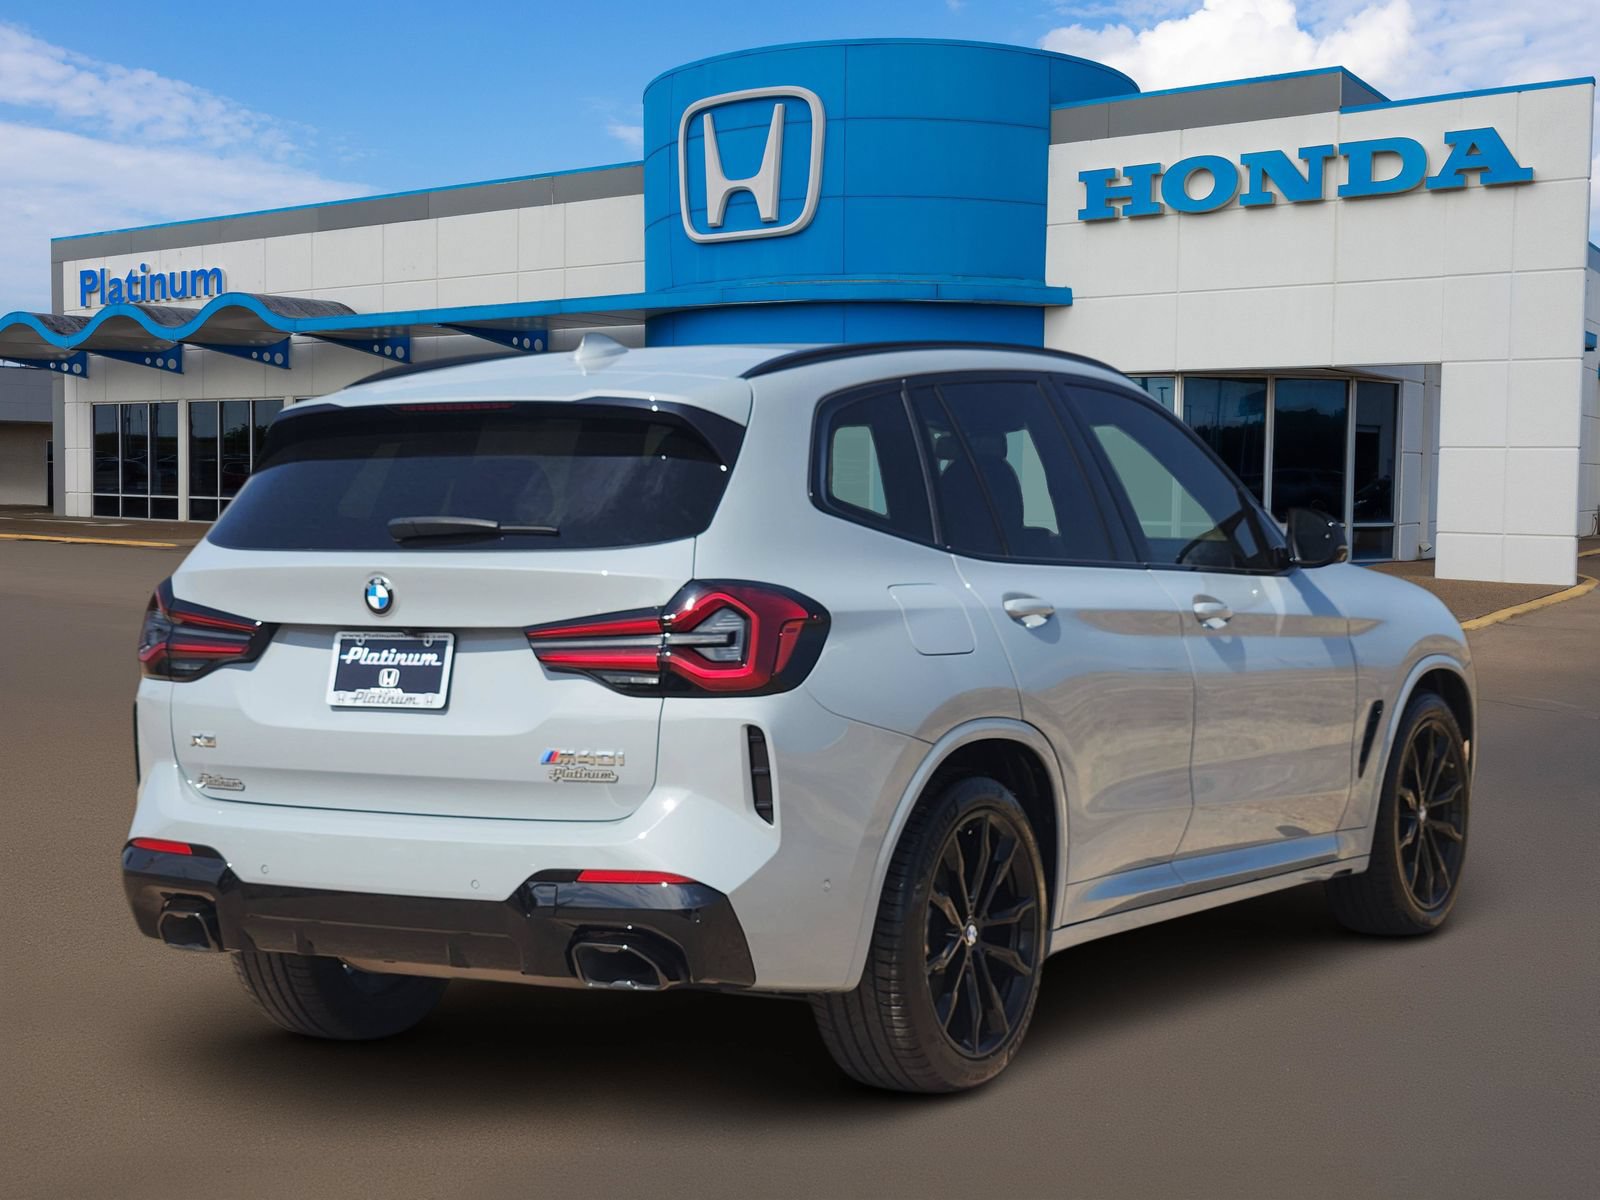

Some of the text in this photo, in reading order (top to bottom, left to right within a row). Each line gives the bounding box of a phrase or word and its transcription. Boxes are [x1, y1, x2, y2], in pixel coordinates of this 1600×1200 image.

[1077, 126, 1535, 223] HONDA
[79, 262, 227, 308] Platinum
[340, 646, 443, 666] Platinum
[350, 690, 420, 705] Platinum
